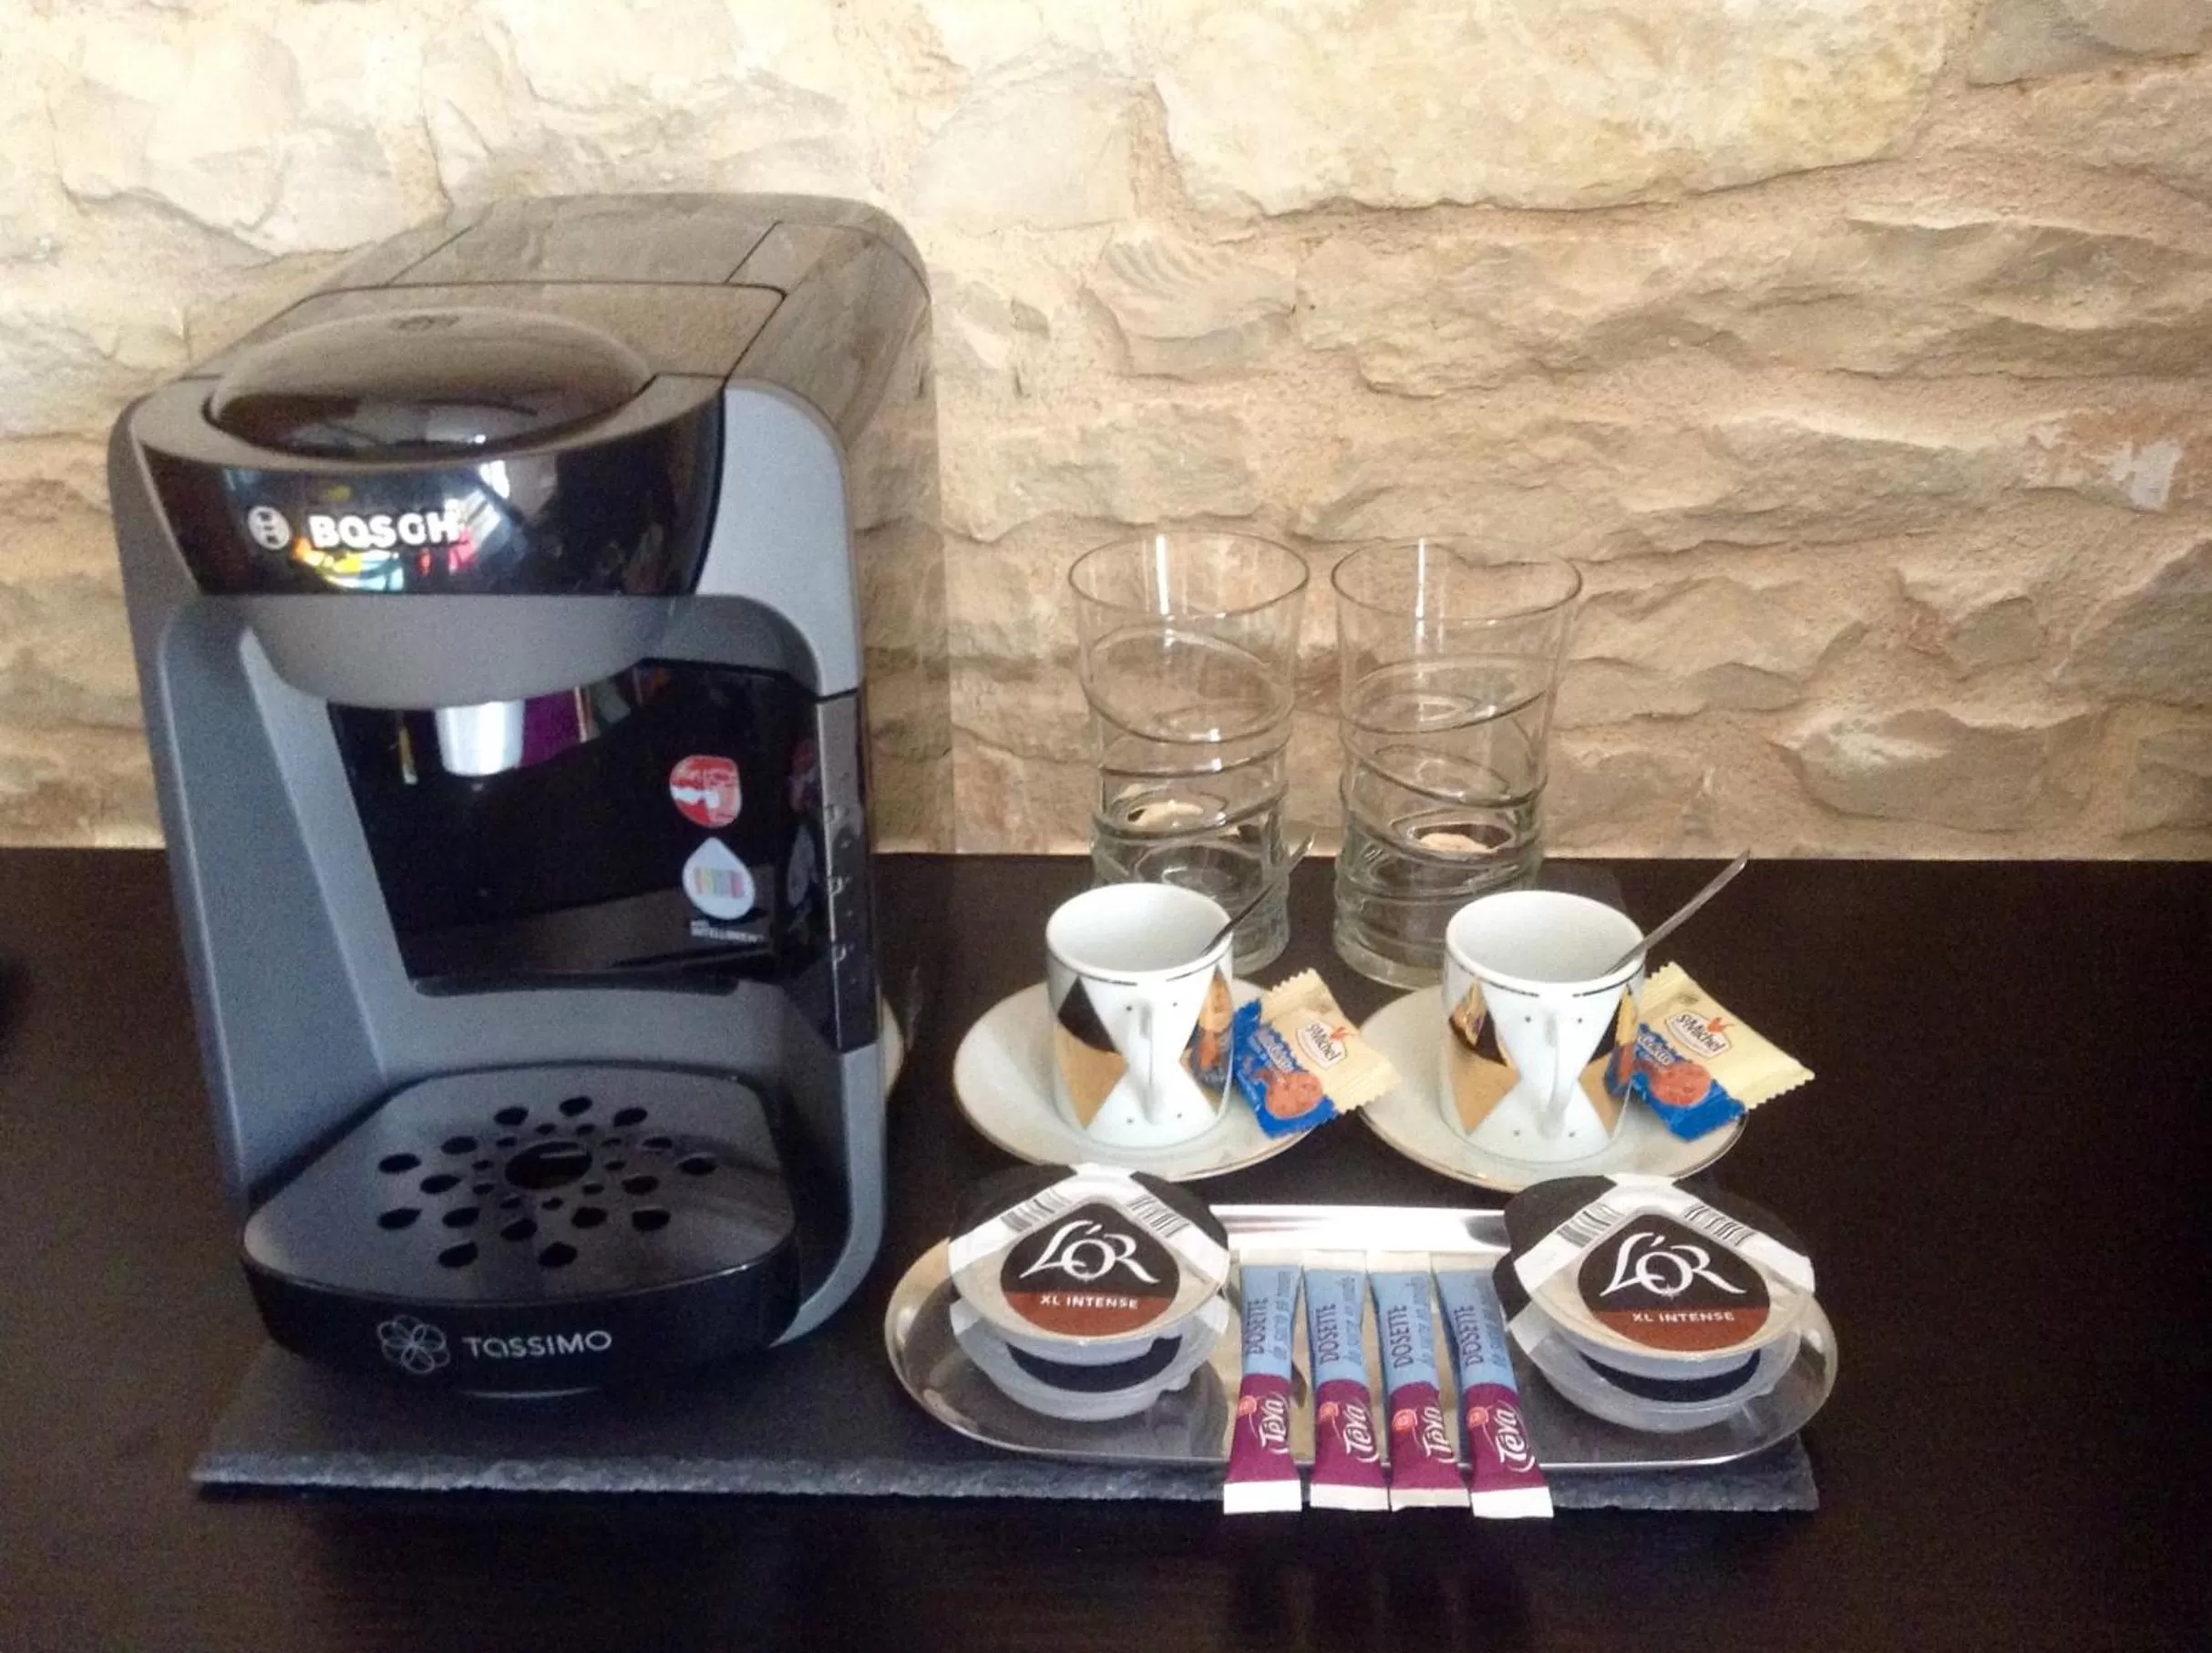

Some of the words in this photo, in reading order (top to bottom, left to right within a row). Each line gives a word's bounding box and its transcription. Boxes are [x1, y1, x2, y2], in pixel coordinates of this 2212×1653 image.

[307, 511, 461, 548] BOSCH
[1040, 1294, 1060, 1306] XL
[1065, 1296, 1138, 1309] INTENSE
[1245, 1298, 1270, 1355] DOSETTE
[1631, 1311, 1653, 1323] XL
[1659, 1311, 1735, 1323] INTENSE
[1316, 1303, 1340, 1364] DOSETTE
[1387, 1304, 1415, 1368] DOSETTE
[1454, 1305, 1485, 1367] DOSETTE
